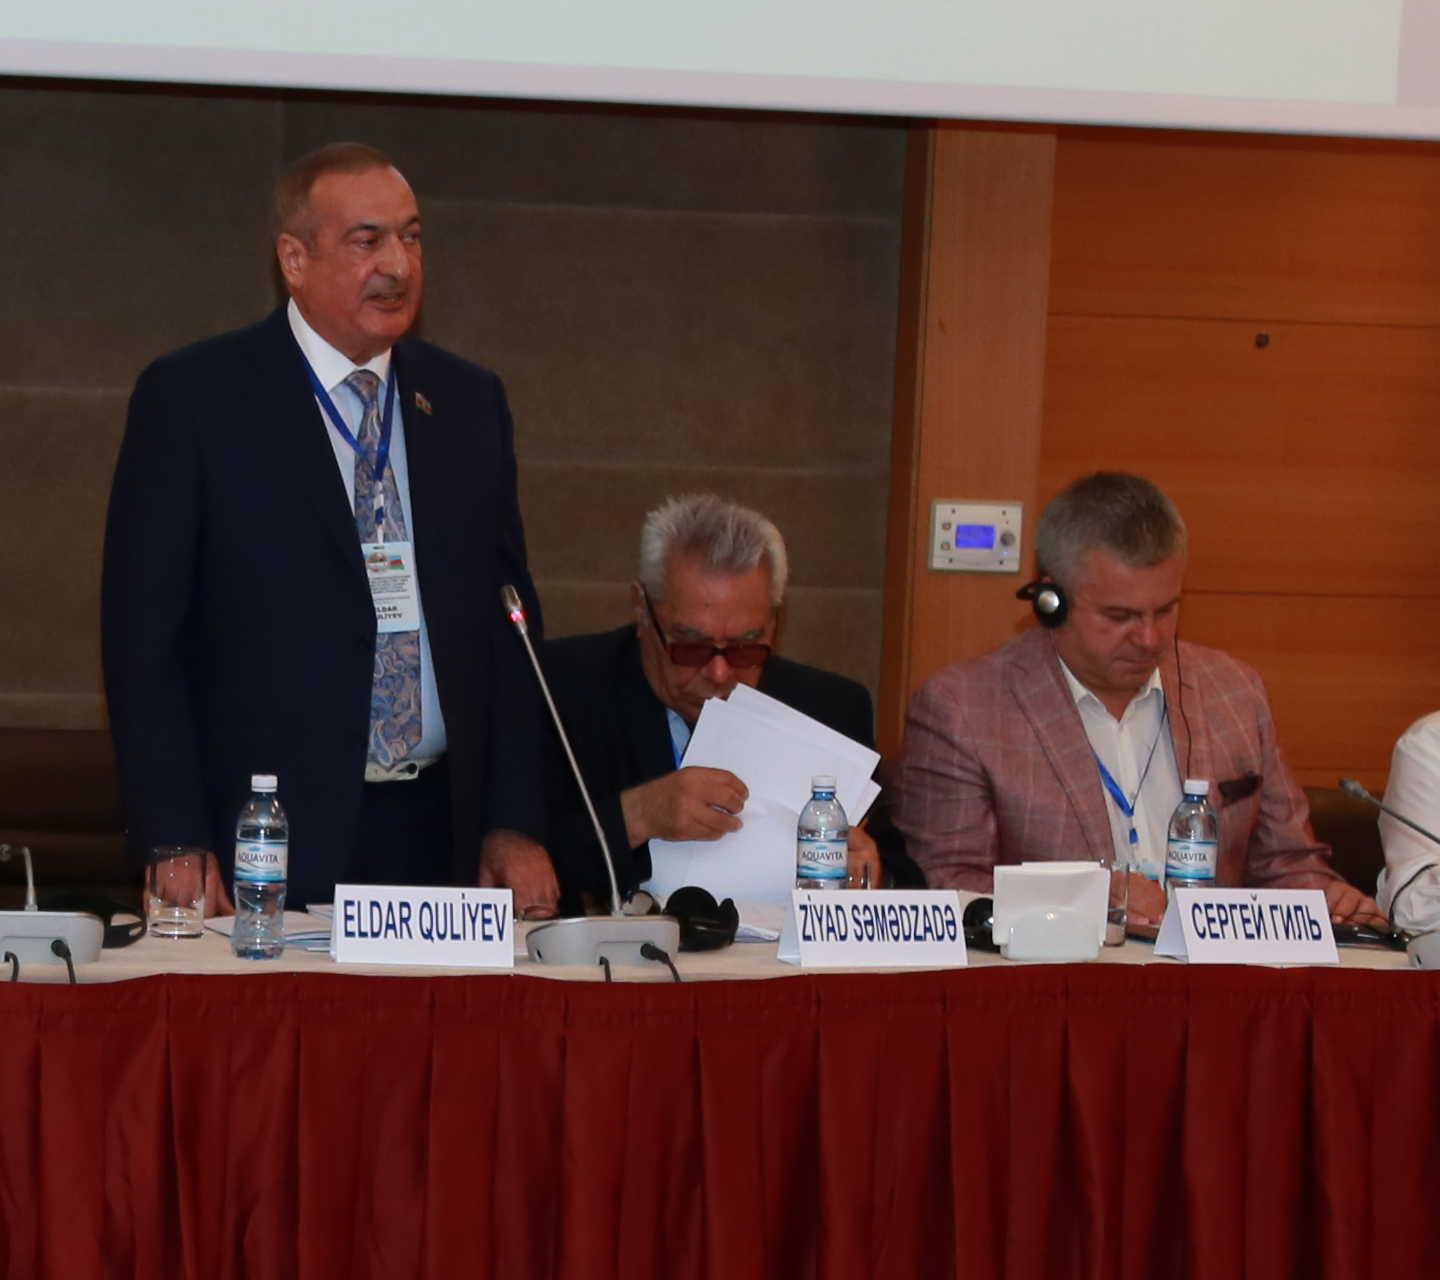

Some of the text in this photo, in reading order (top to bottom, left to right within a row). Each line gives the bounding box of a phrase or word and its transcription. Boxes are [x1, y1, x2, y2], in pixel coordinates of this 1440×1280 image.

[237, 852, 279, 864] AQUAVITA
[802, 850, 844, 861] AQUAVITA
[344, 893, 506, 942] ELDAR QULİYEV
[799, 895, 957, 942] ZİYAD SƏMƏDZADƏ
[1192, 895, 1322, 940] СЕРГЕЙ ГИЛЬ
